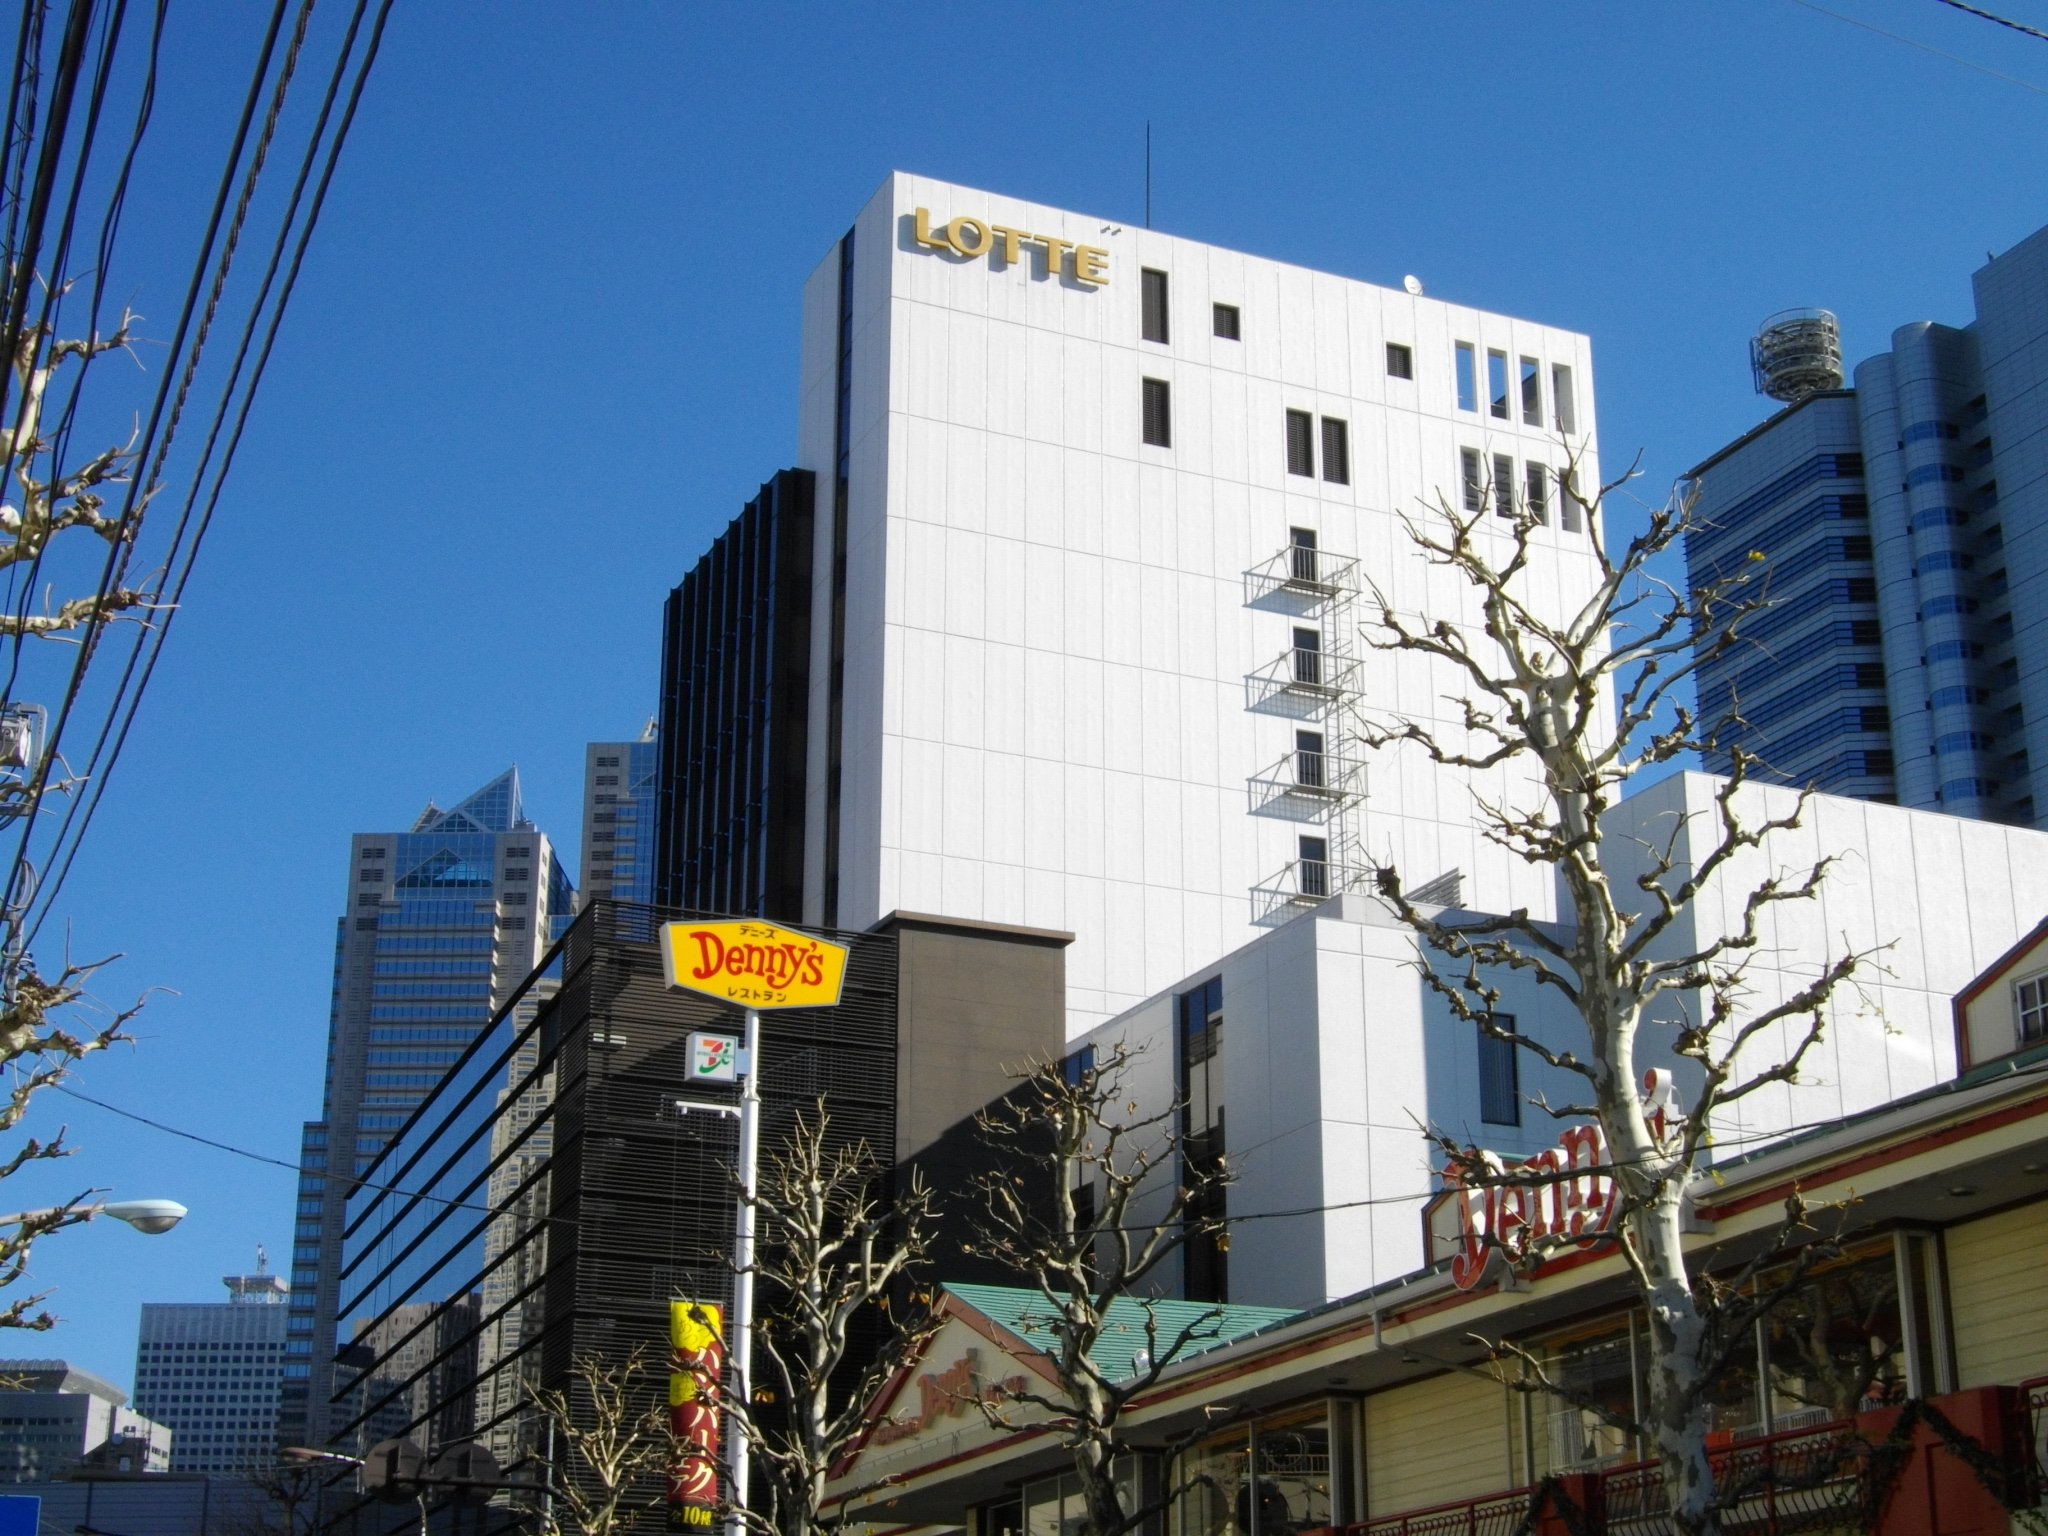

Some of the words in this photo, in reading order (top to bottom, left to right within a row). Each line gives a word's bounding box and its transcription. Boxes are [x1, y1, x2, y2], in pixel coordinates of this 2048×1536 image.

[915, 206, 1110, 286] LOTTE
[739, 925, 779, 939] デニーズ
[689, 931, 824, 990] Denny's
[727, 986, 787, 1003] レストラン
